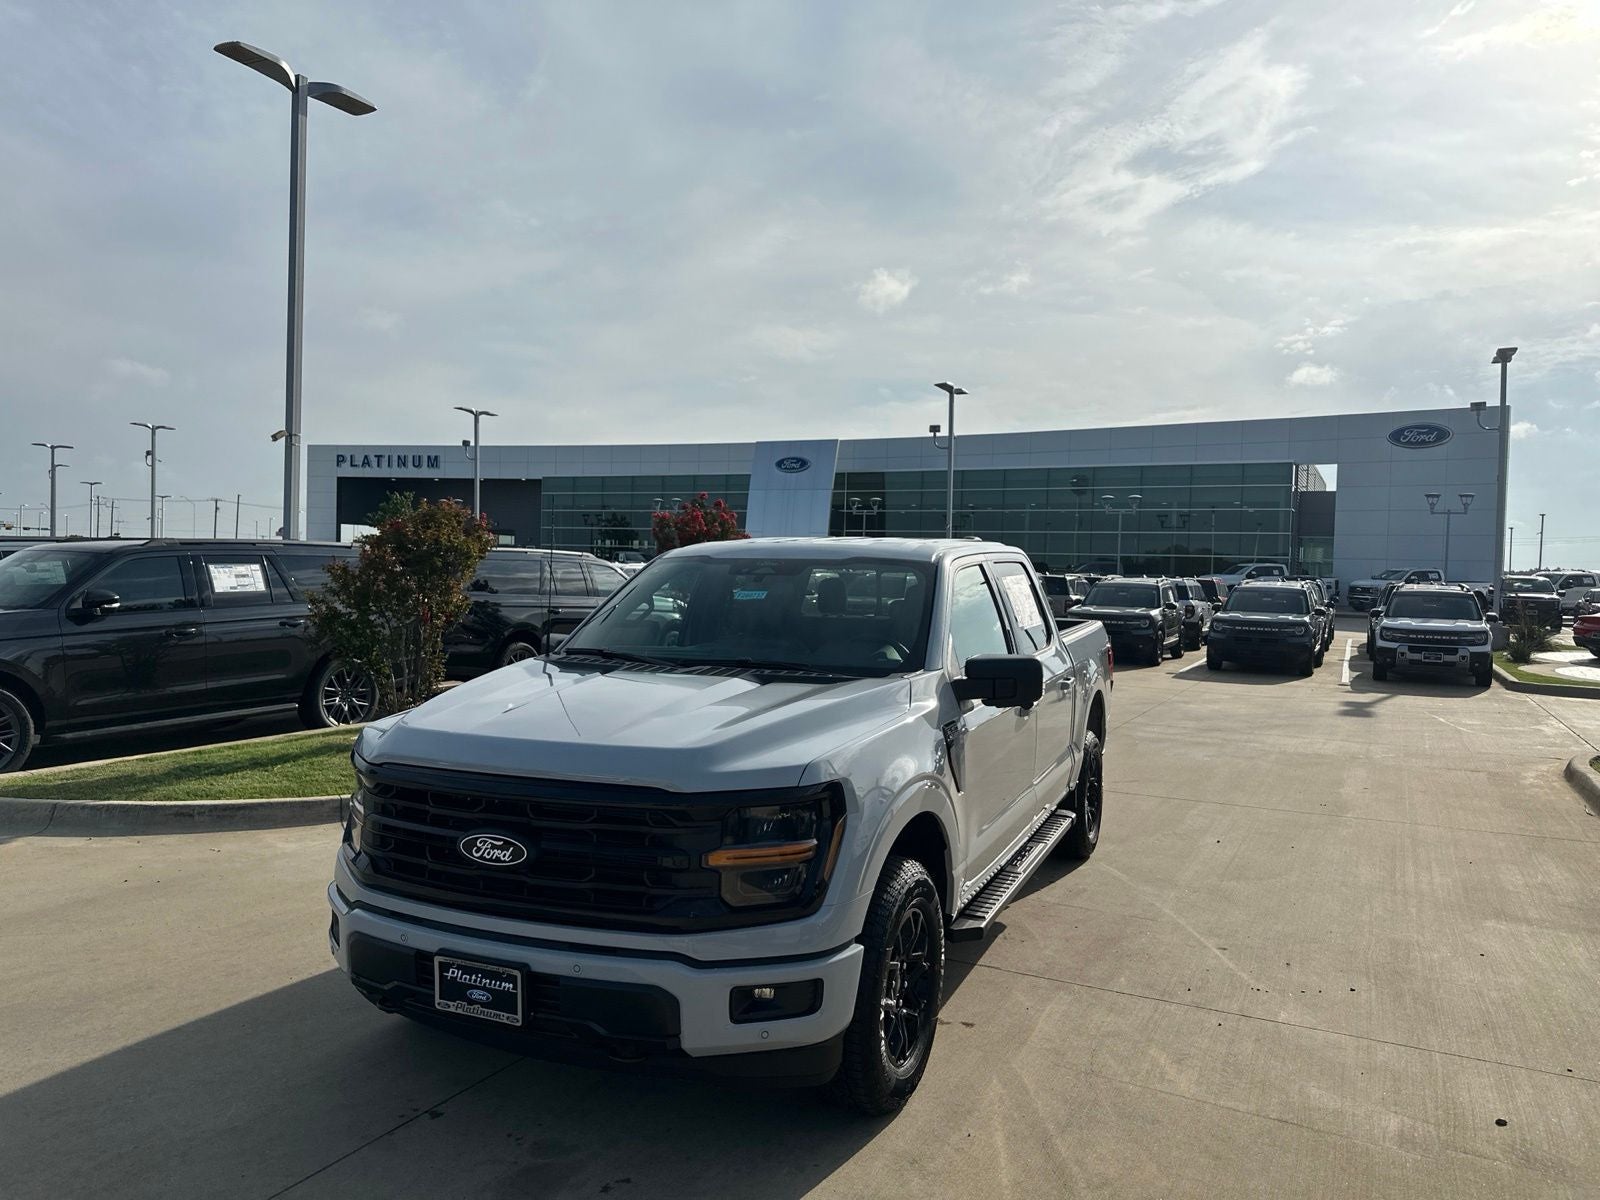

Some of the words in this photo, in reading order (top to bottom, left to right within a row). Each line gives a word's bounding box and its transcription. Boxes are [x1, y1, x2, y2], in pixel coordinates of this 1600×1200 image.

[1400, 428, 1438, 443] Ford
[336, 454, 440, 469] PLATINUM
[472, 837, 514, 861] Ford
[443, 968, 517, 993] Platinum
[455, 1002, 503, 1021] Platinum
